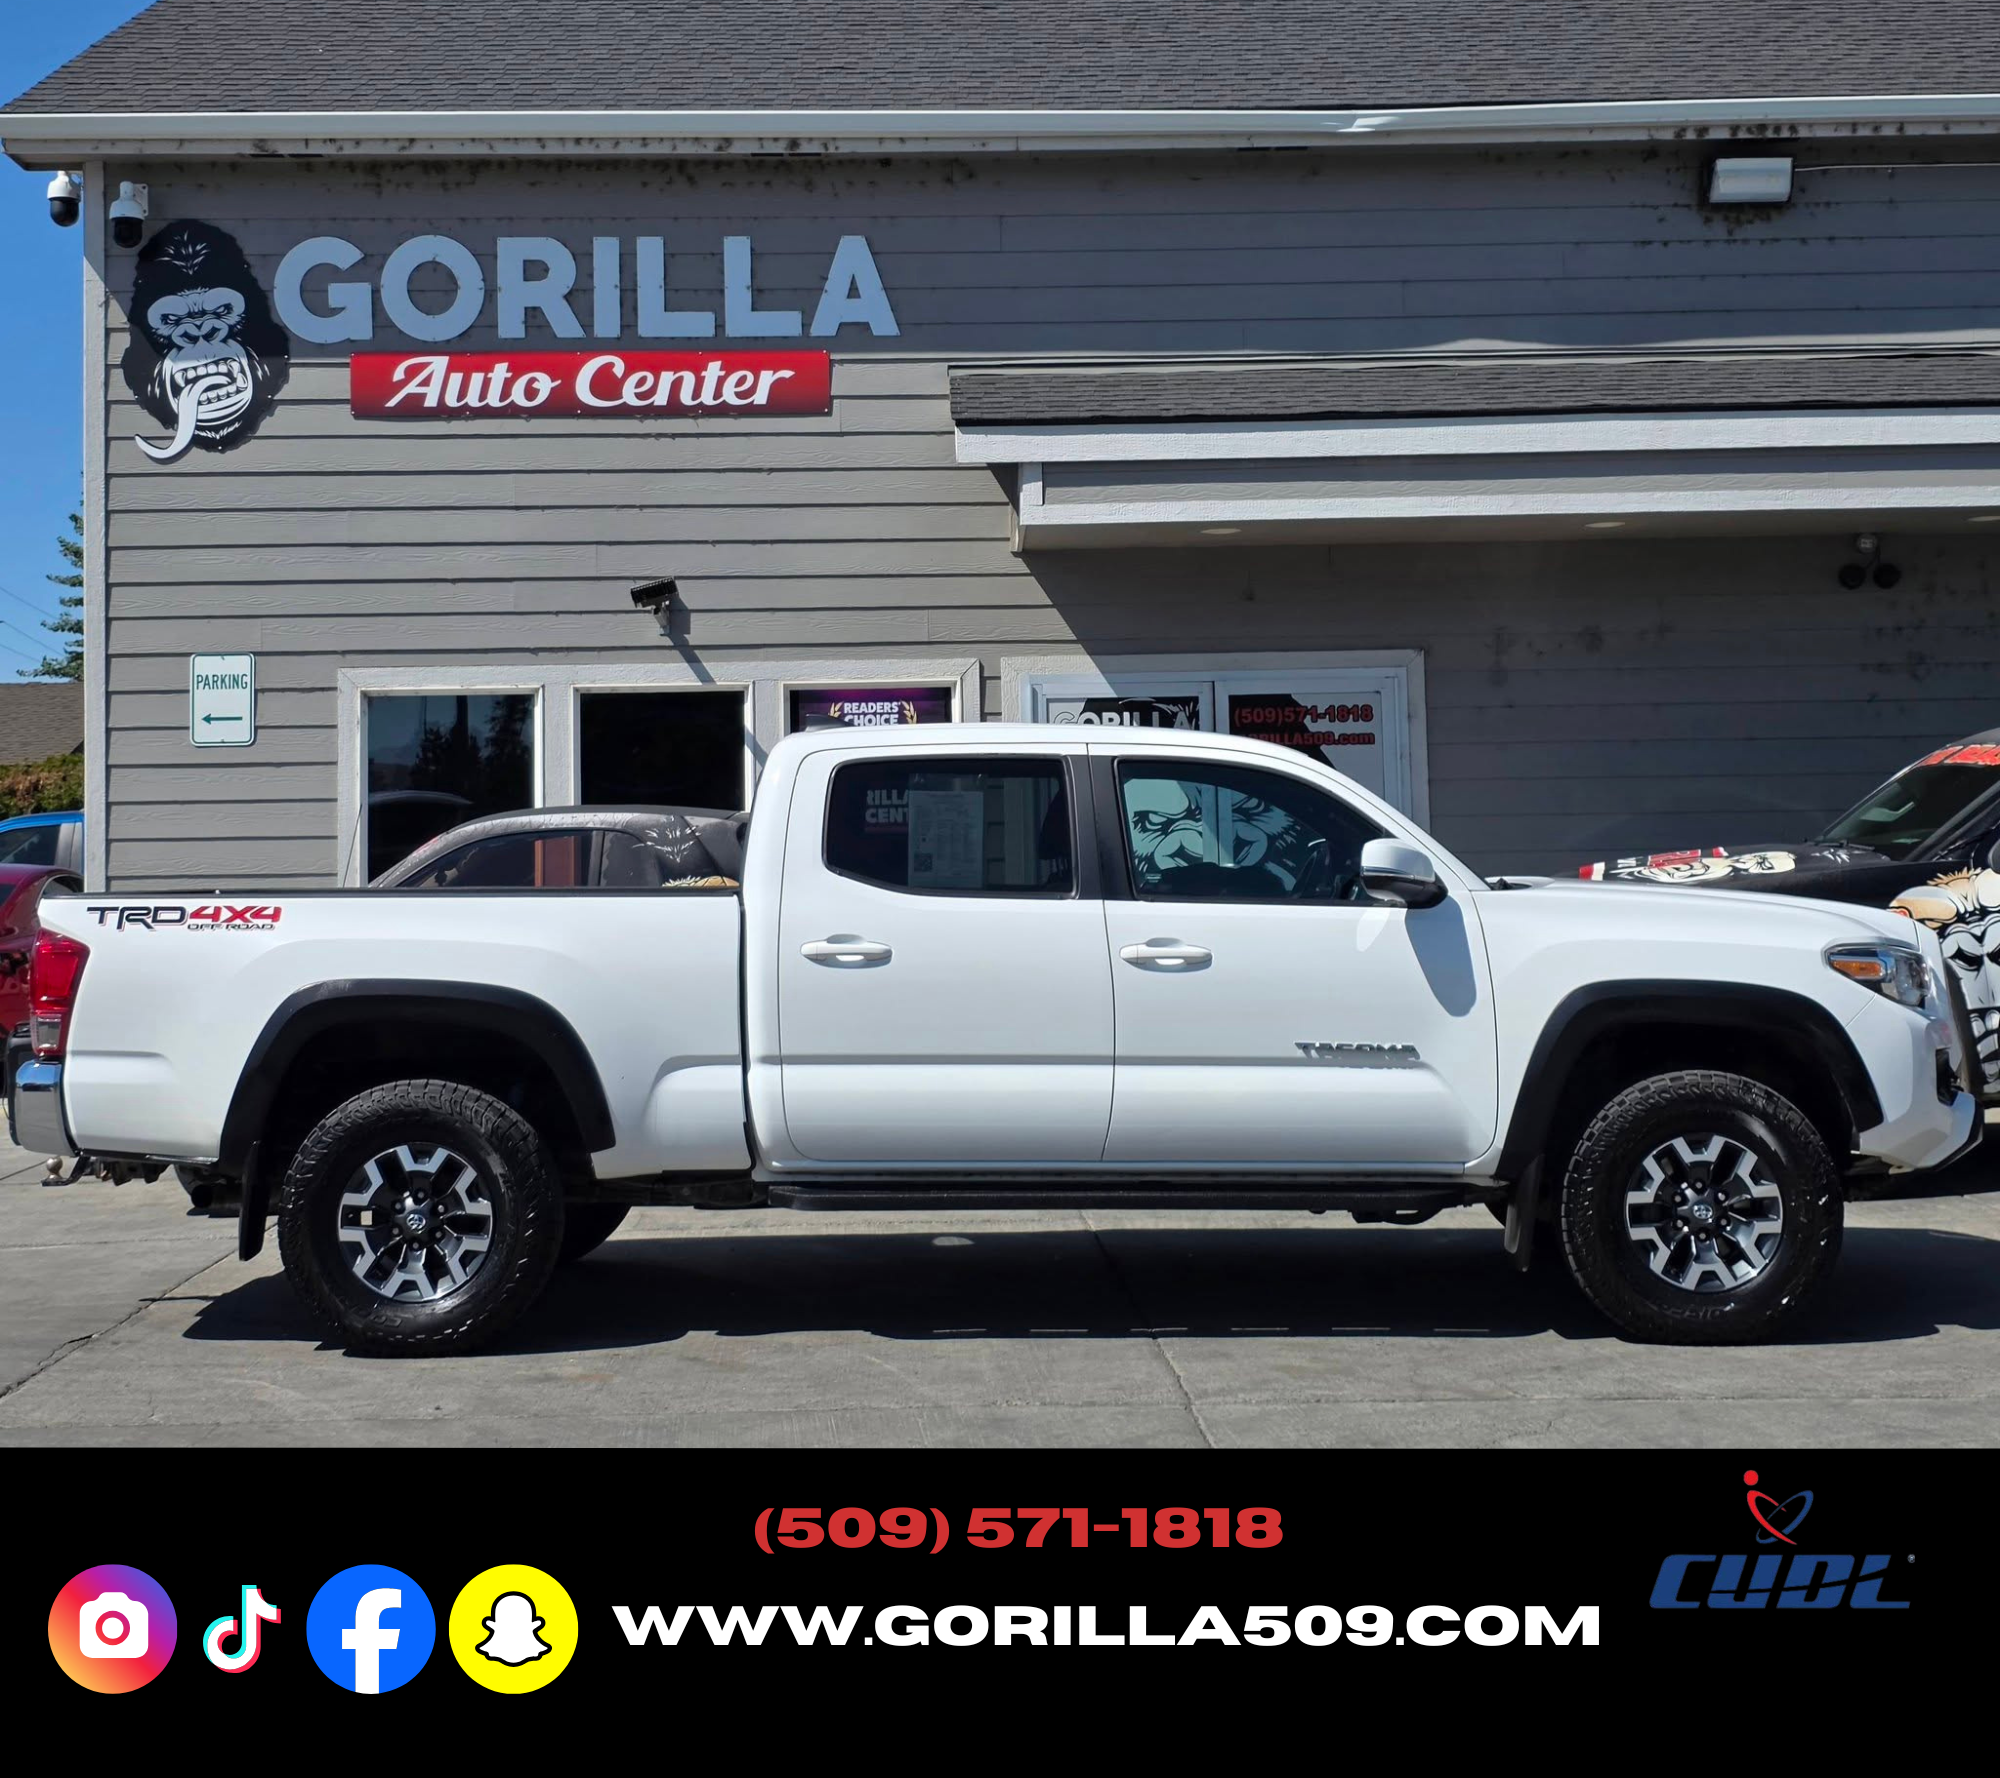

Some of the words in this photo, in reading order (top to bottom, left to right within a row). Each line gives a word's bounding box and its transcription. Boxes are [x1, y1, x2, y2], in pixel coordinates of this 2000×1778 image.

[273, 234, 901, 343] GORILLA
[385, 355, 561, 409] Auto
[575, 355, 794, 408] Center
[196, 673, 248, 690] PARKING
[1234, 704, 1374, 727] (509)571-1818
[187, 923, 224, 932] OFF
[226, 923, 275, 931] ROAD
[1294, 1042, 1421, 1061] TACOMA
